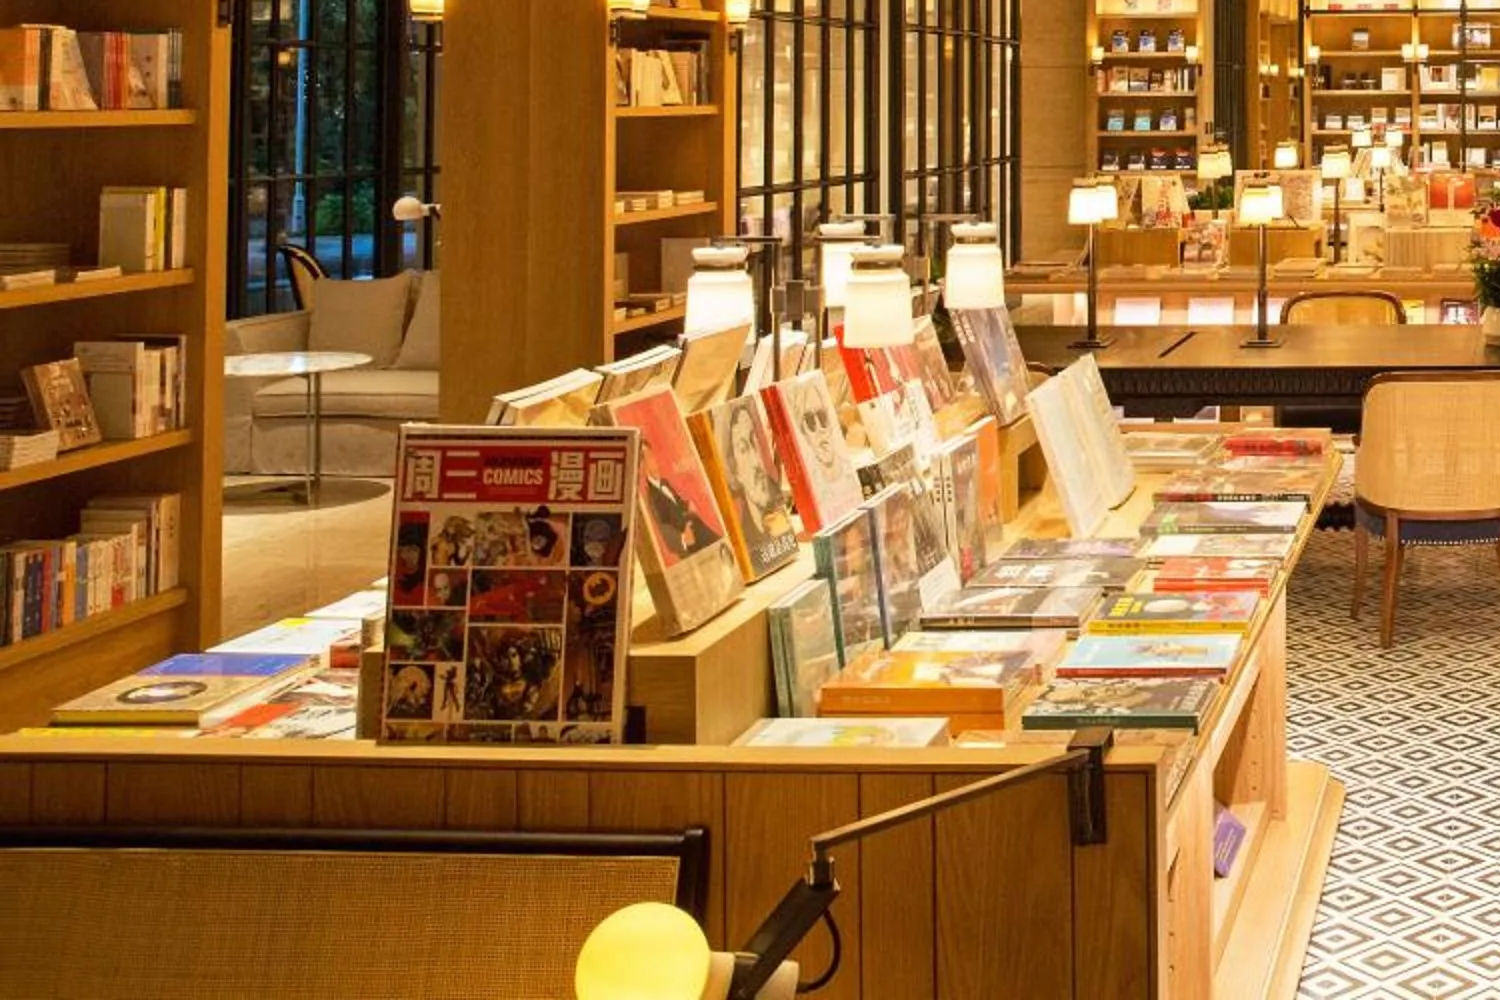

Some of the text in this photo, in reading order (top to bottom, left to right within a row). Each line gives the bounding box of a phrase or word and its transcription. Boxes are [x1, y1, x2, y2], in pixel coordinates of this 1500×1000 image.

[404, 450, 625, 501] 周三 漫画
[482, 467, 544, 486] COMICS
